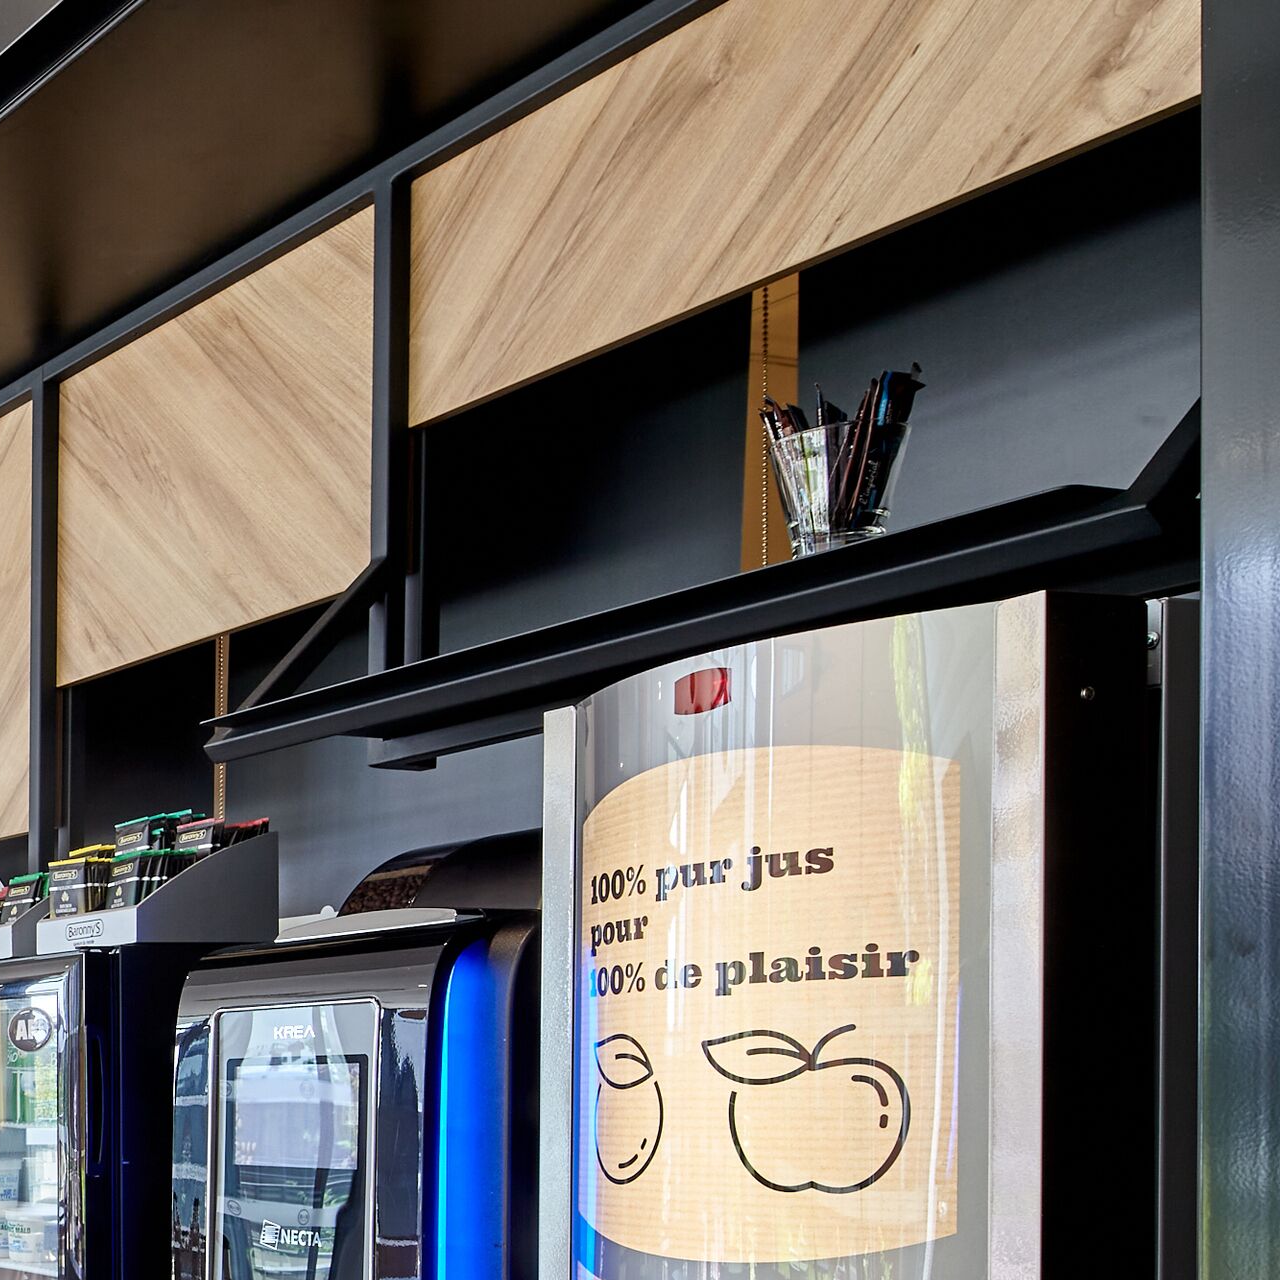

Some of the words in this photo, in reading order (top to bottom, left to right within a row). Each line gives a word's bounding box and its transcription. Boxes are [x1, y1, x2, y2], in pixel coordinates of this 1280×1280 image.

[591, 864, 646, 904] 100%
[655, 857, 733, 902] pur
[740, 846, 835, 891] jus
[591, 915, 648, 956] pour
[590, 962, 646, 997] 100%
[654, 959, 702, 990] de
[715, 943, 920, 996] plaisir
[280, 1228, 322, 1247] NECTA
